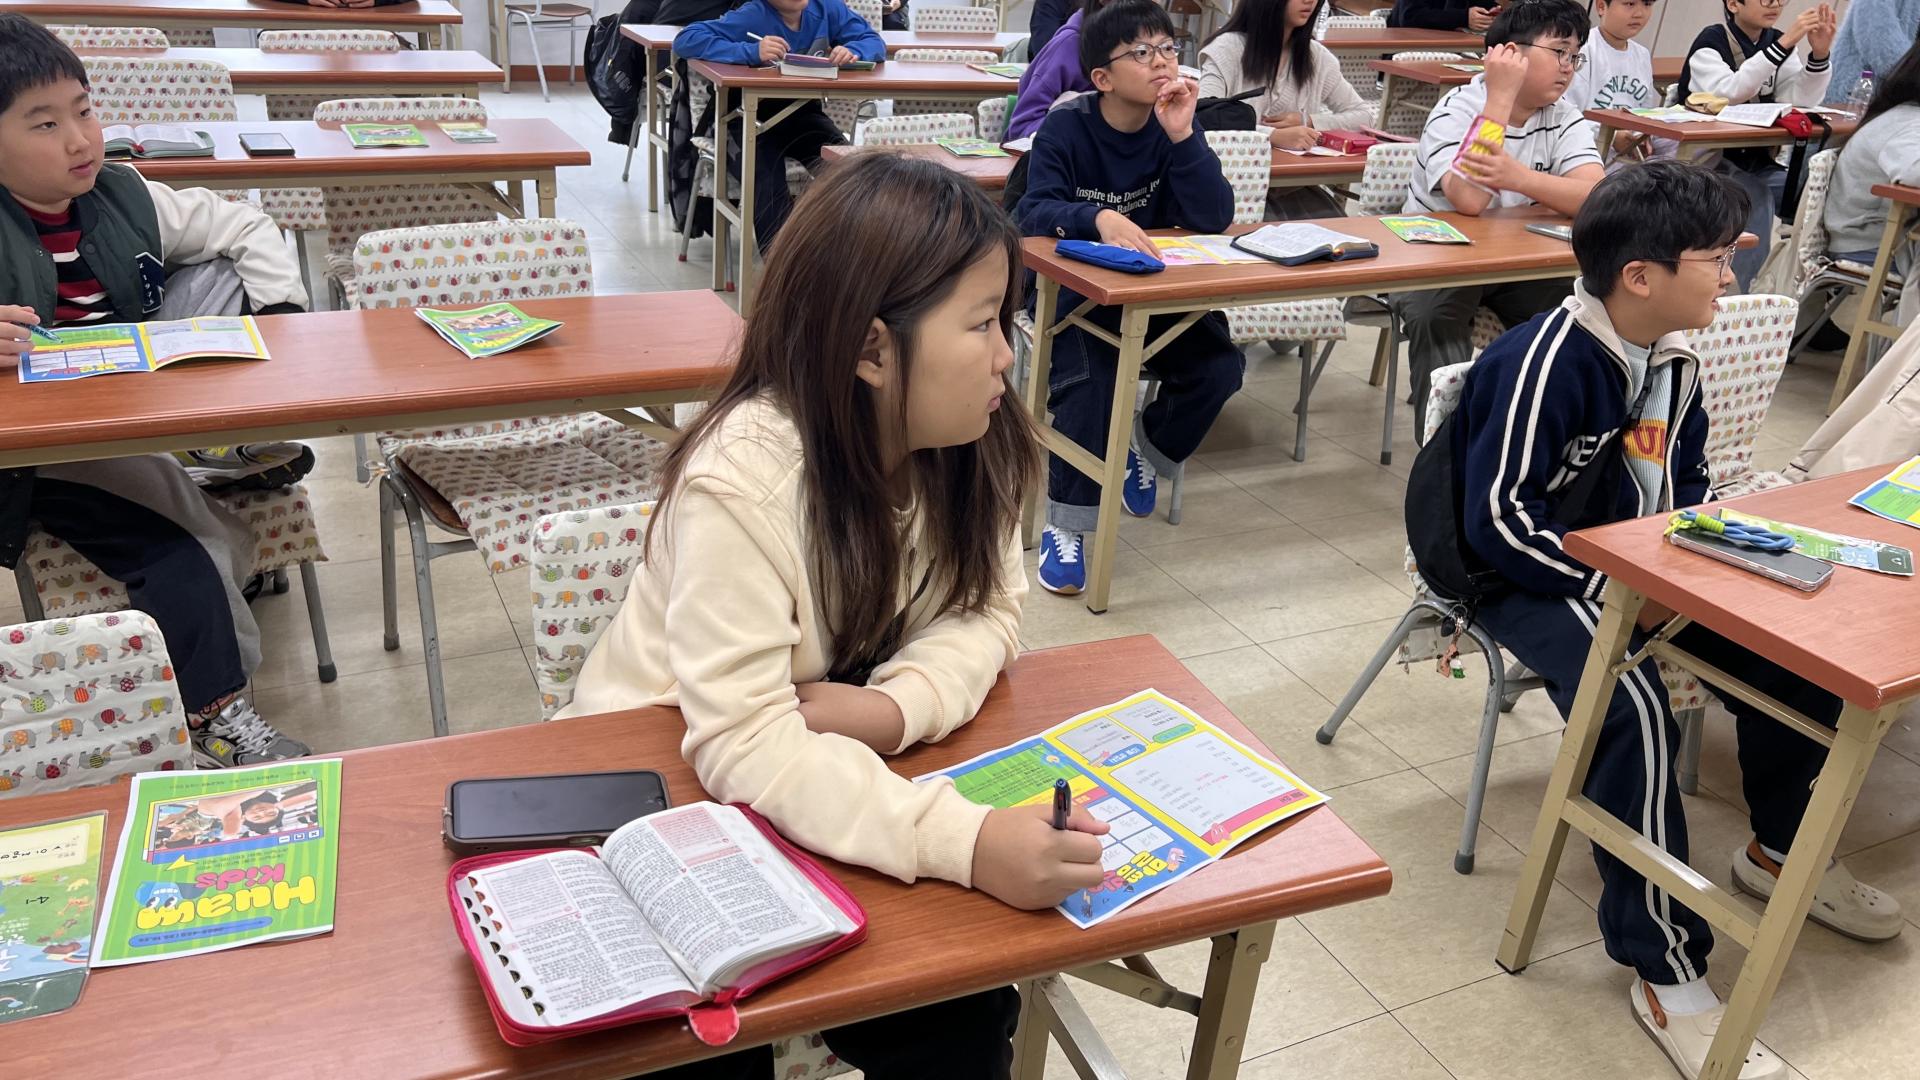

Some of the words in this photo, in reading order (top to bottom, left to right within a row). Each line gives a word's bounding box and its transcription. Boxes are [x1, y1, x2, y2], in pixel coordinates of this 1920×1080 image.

[1591, 75, 1648, 110] MINNESO
[1076, 186, 1105, 201] Inspire
[1107, 192, 1123, 204] the
[1123, 187, 1148, 202] Dream
[212, 739, 231, 757] N
[194, 863, 286, 891] Kids
[25, 896, 50, 905] 4-1
[136, 875, 317, 930] Huam
